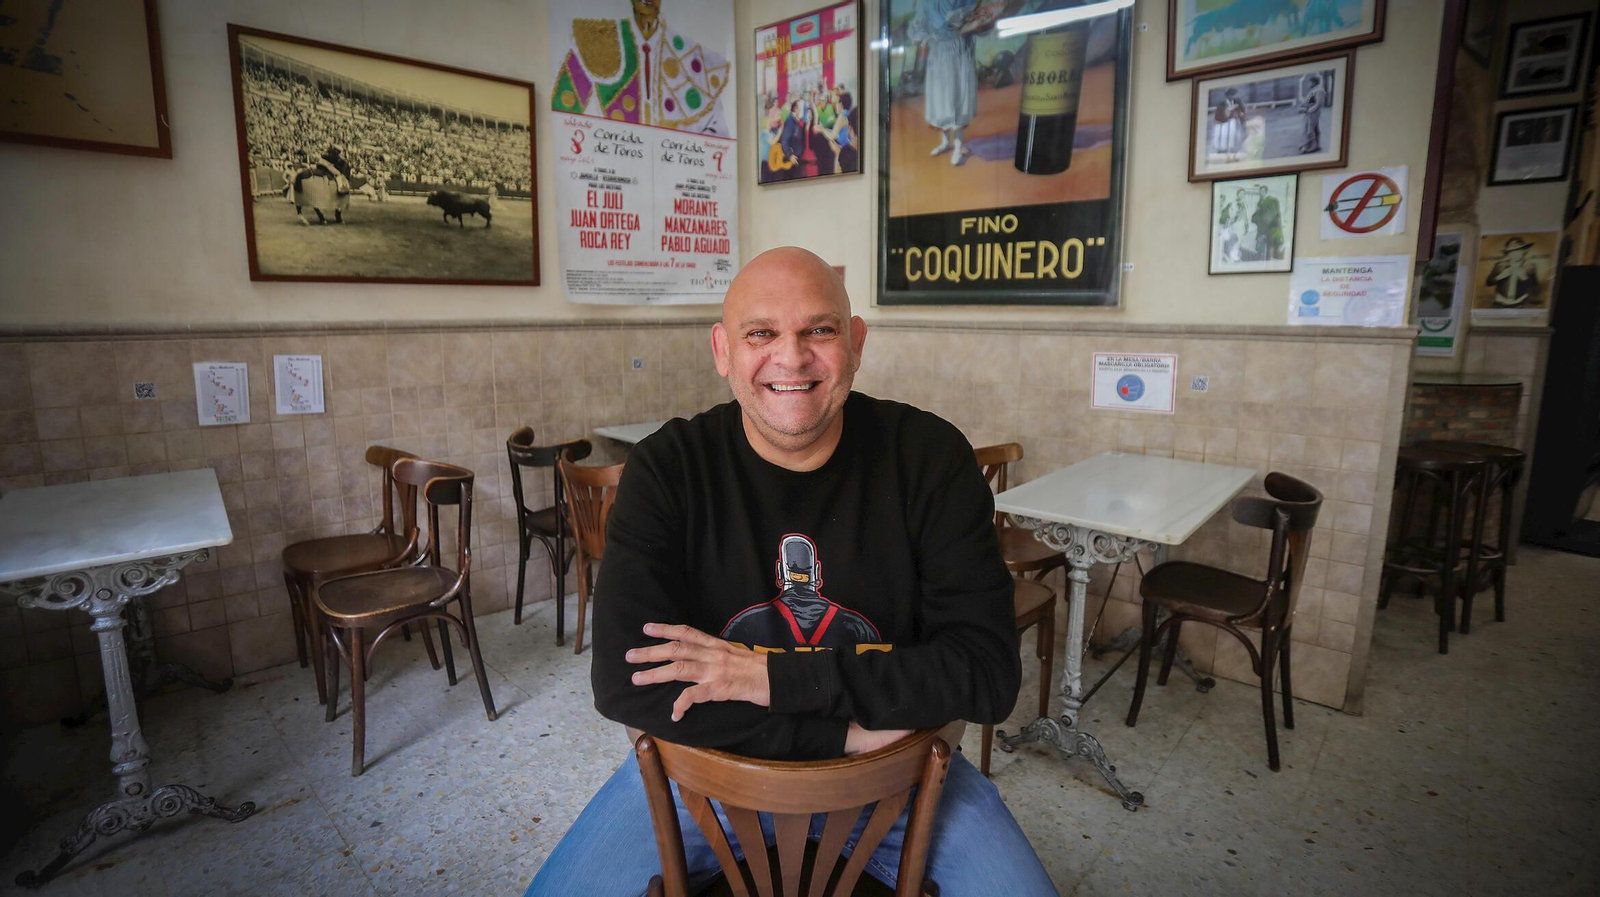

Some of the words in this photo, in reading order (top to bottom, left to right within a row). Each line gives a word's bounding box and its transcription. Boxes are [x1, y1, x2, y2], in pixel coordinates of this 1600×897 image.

[776, 41, 836, 75] CABALLO
[570, 129, 585, 155] 8
[594, 128, 645, 145] Corrida
[661, 138, 706, 154] Corrida
[593, 142, 611, 155] de
[613, 144, 644, 159] Toros
[661, 151, 676, 163] de
[678, 153, 705, 167] Toros
[712, 151, 724, 172] 9
[401, 172, 417, 184] TIO
[421, 174, 444, 186] PEPE
[587, 190, 599, 209] EL
[602, 192, 624, 210] JULI
[674, 197, 719, 218] MORANTE
[570, 208, 597, 228] JUAN
[600, 211, 641, 231] ORTEGA
[664, 216, 728, 237] MANZANARES
[961, 213, 1019, 235] FINO
[580, 230, 608, 249] ROCA
[611, 232, 632, 251] REY
[661, 235, 691, 253] PABLO
[694, 237, 731, 255] AGUADO
[669, 257, 676, 268] 7
[1322, 266, 1374, 275] MANTENGA
[1320, 275, 1331, 283] LA
